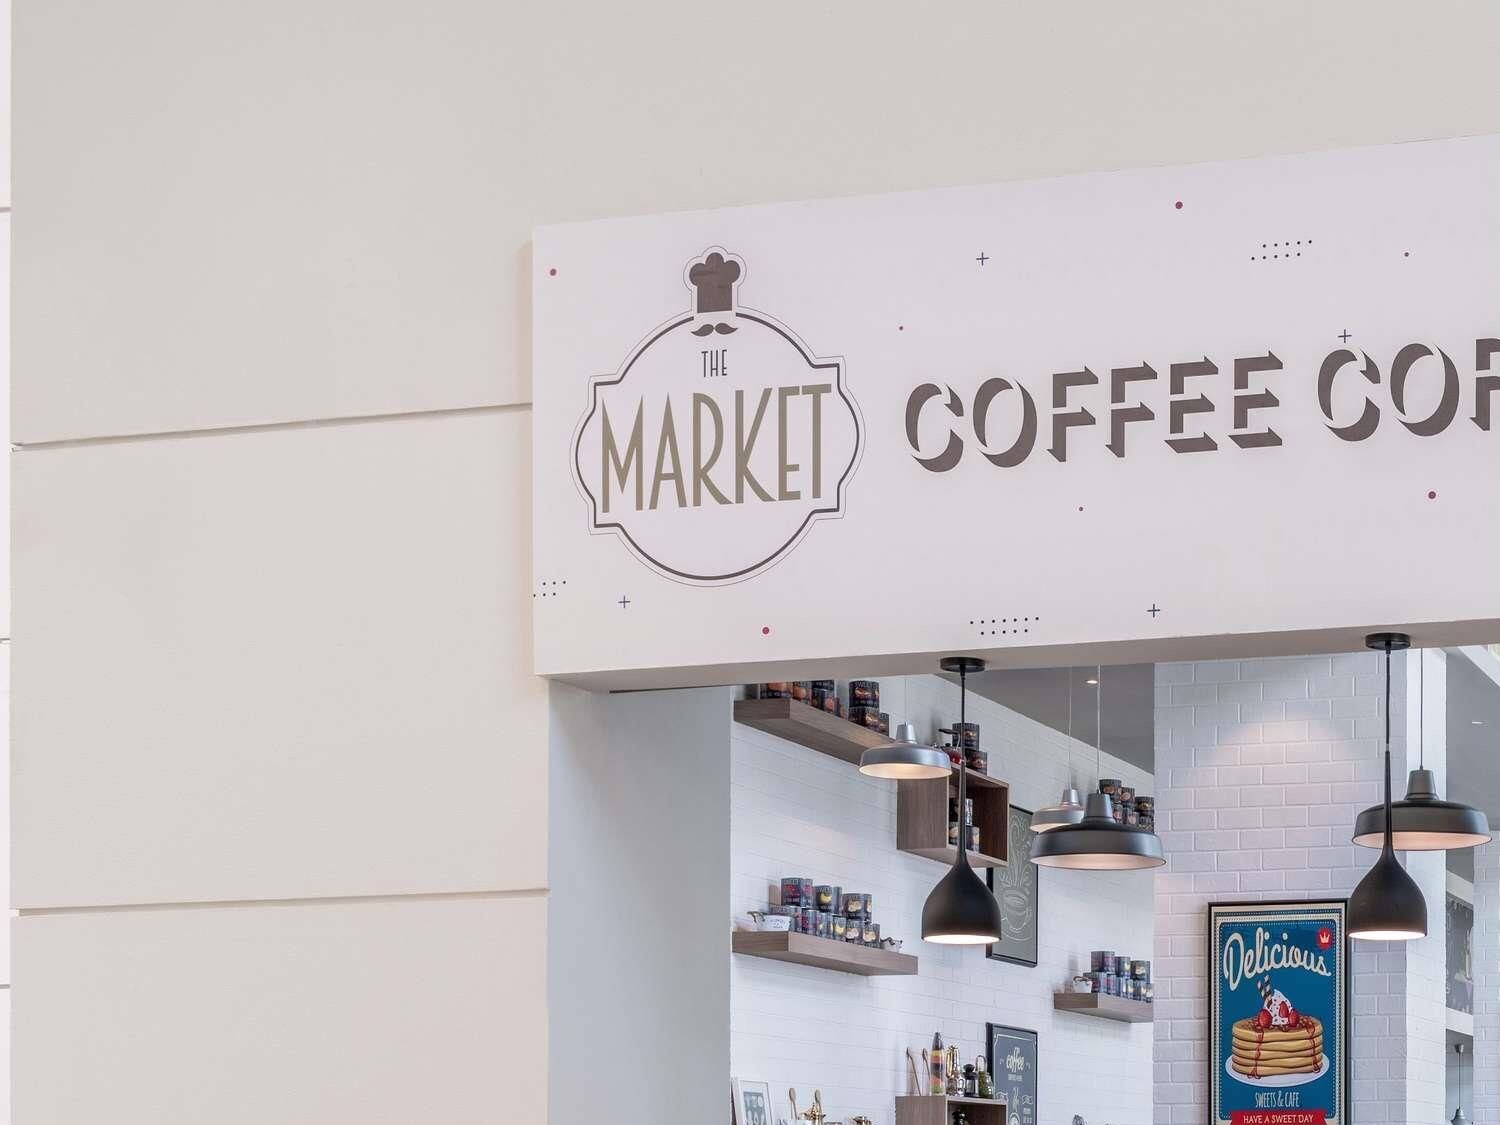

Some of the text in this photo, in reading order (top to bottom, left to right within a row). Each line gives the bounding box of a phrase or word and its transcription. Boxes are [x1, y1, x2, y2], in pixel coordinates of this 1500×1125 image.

[701, 349, 728, 378] THE
[903, 349, 1285, 473] COFFEE
[601, 383, 832, 514] MARKET
[1223, 927, 1332, 991] Delicious
[1243, 1114, 1314, 1124] HAVE A SWEET DAY
[1255, 1092, 1276, 1108] SWEETS
[1285, 1092, 1300, 1107] CAFE
